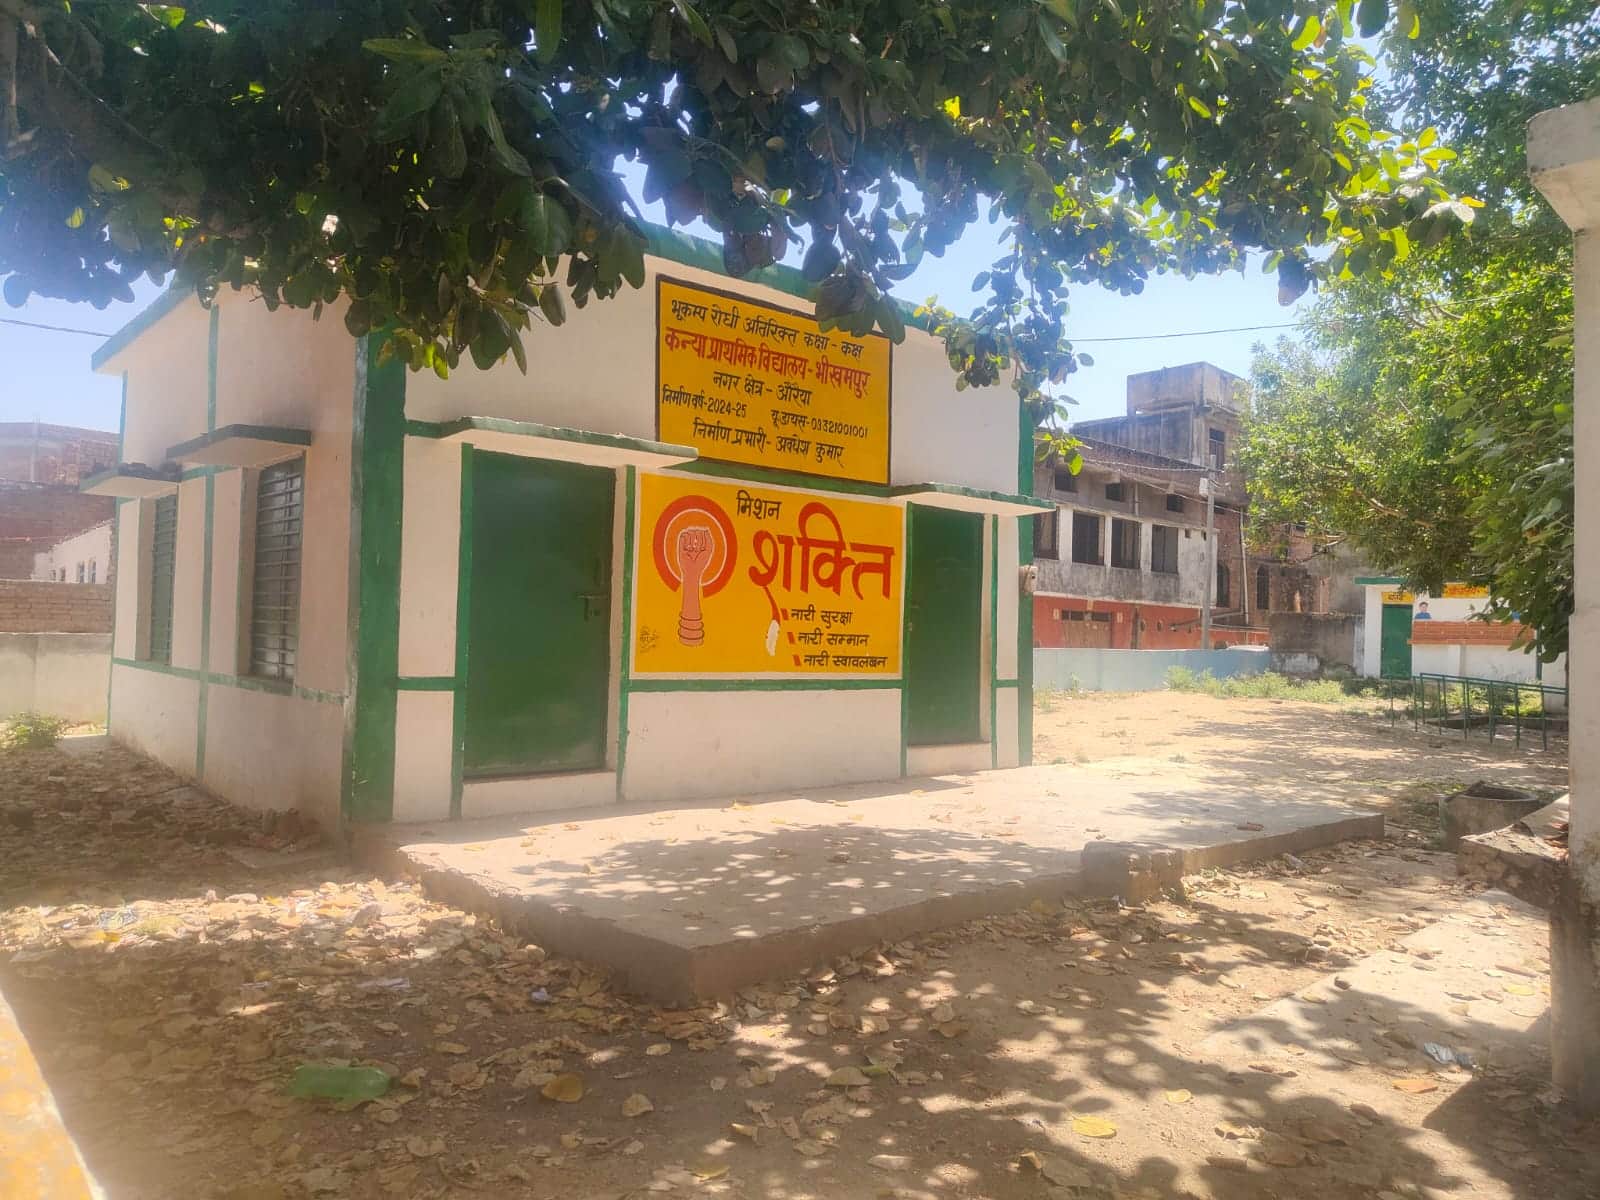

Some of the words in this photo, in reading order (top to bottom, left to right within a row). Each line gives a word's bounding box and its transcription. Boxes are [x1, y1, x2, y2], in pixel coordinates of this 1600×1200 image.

[711, 303, 740, 329] रोधी
[743, 315, 800, 347] अतिरिक्त
[804, 331, 830, 352] कक्षा
[841, 341, 864, 360] कक्ष
[665, 326, 708, 359] कन्या
[706, 337, 758, 368] प्राथमिक
[815, 355, 871, 399] भीखमपुर
[662, 384, 691, 408] निर्माण
[713, 371, 741, 395] नगर
[744, 374, 765, 398] क्षेत्र
[693, 417, 732, 443] निर्माण
[776, 434, 811, 456] अवधेश
[816, 442, 845, 469] कुमार
[736, 489, 781, 520] मिशन
[748, 502, 895, 600] शक्ति
[791, 604, 816, 621] नारी
[821, 610, 854, 629] सुरक्षा
[798, 628, 824, 645] नारी
[827, 633, 870, 646] सम्मान
[803, 650, 830, 667] नारी
